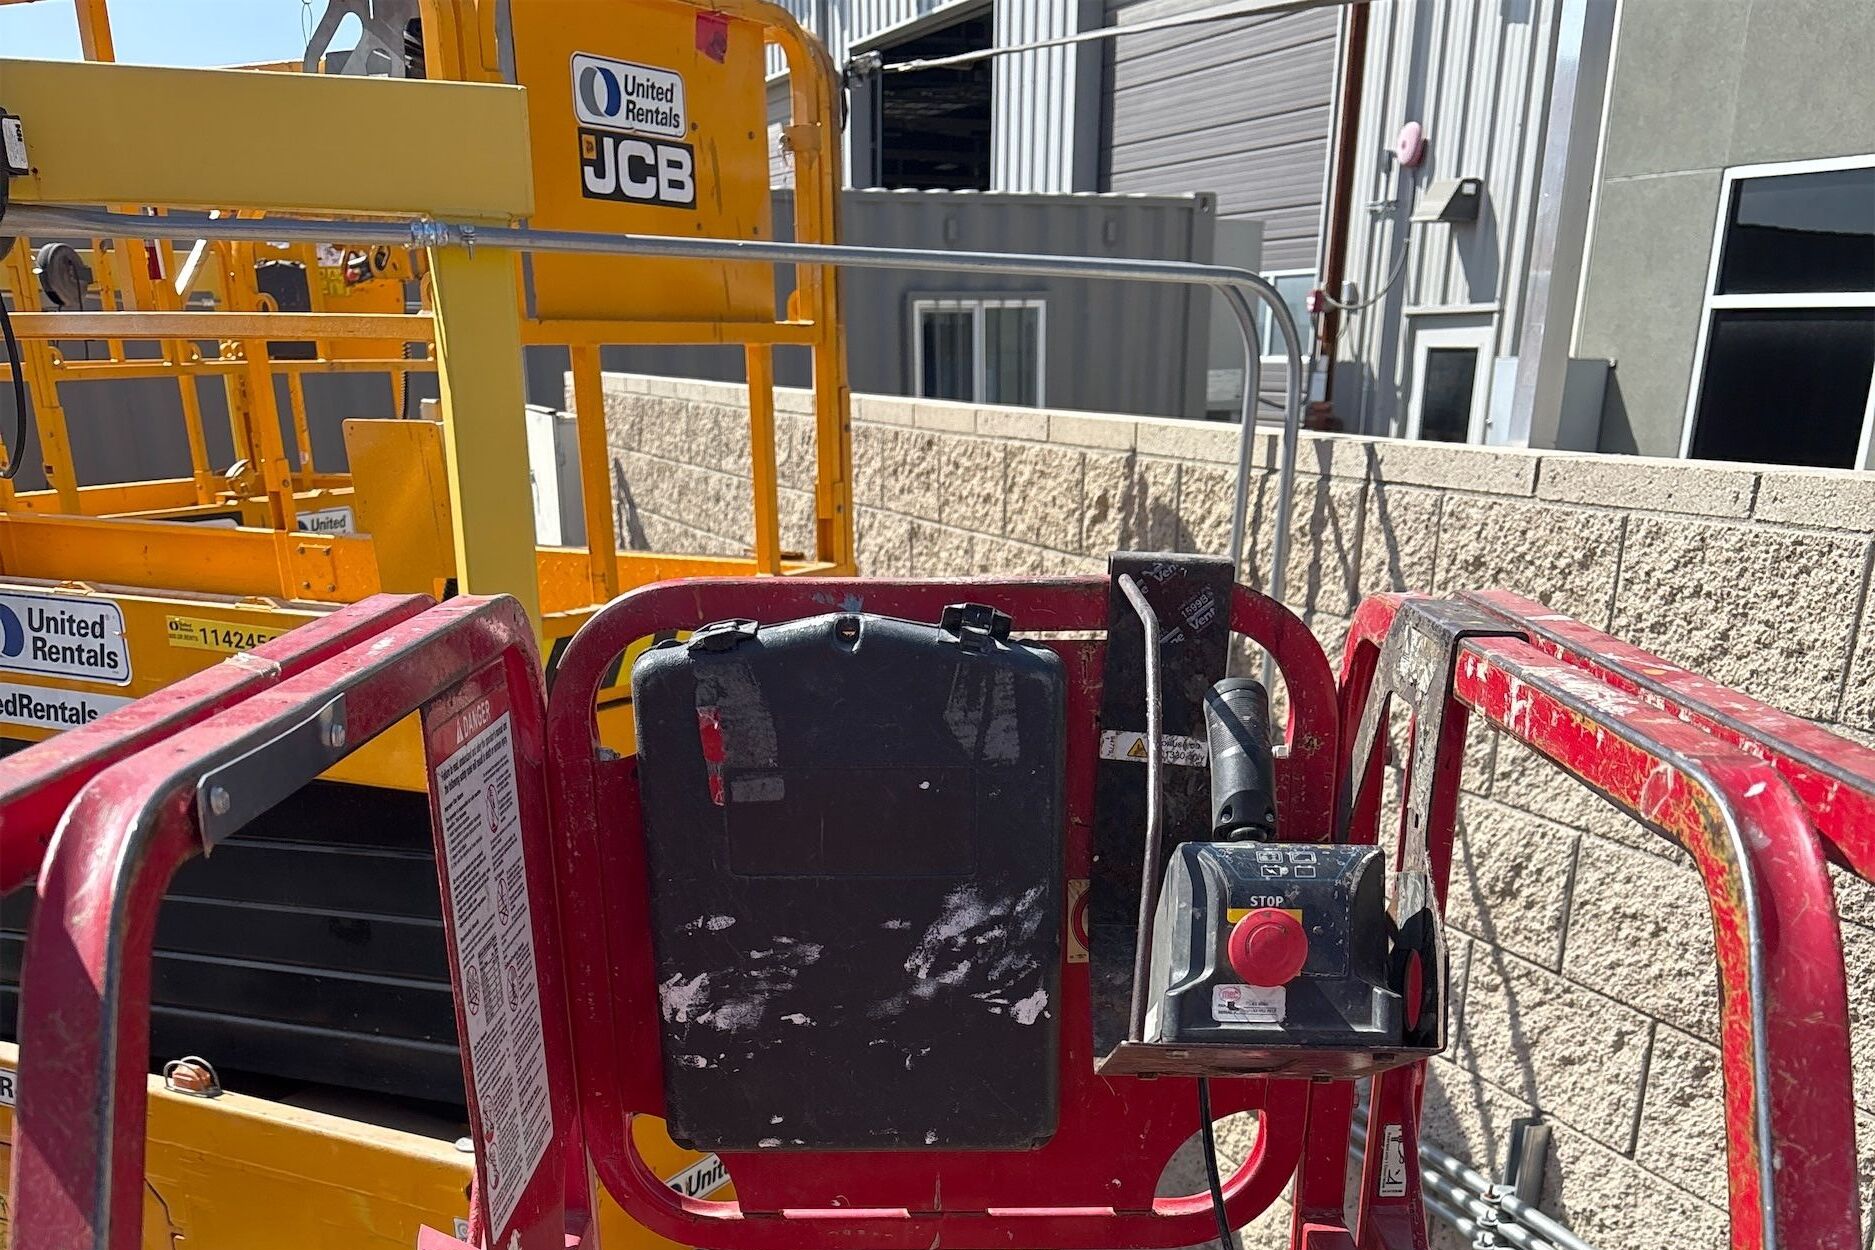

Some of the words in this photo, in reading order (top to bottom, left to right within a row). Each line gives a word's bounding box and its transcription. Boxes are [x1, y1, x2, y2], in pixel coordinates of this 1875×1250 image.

[624, 73, 674, 103] United
[625, 100, 680, 128] Rentals
[583, 137, 694, 203] JCB
[311, 515, 346, 531] United
[28, 607, 105, 640] United
[199, 627, 278, 650] 114245
[32, 636, 119, 669] Rentals
[463, 699, 491, 739] DANGER
[1250, 895, 1284, 907] STOP
